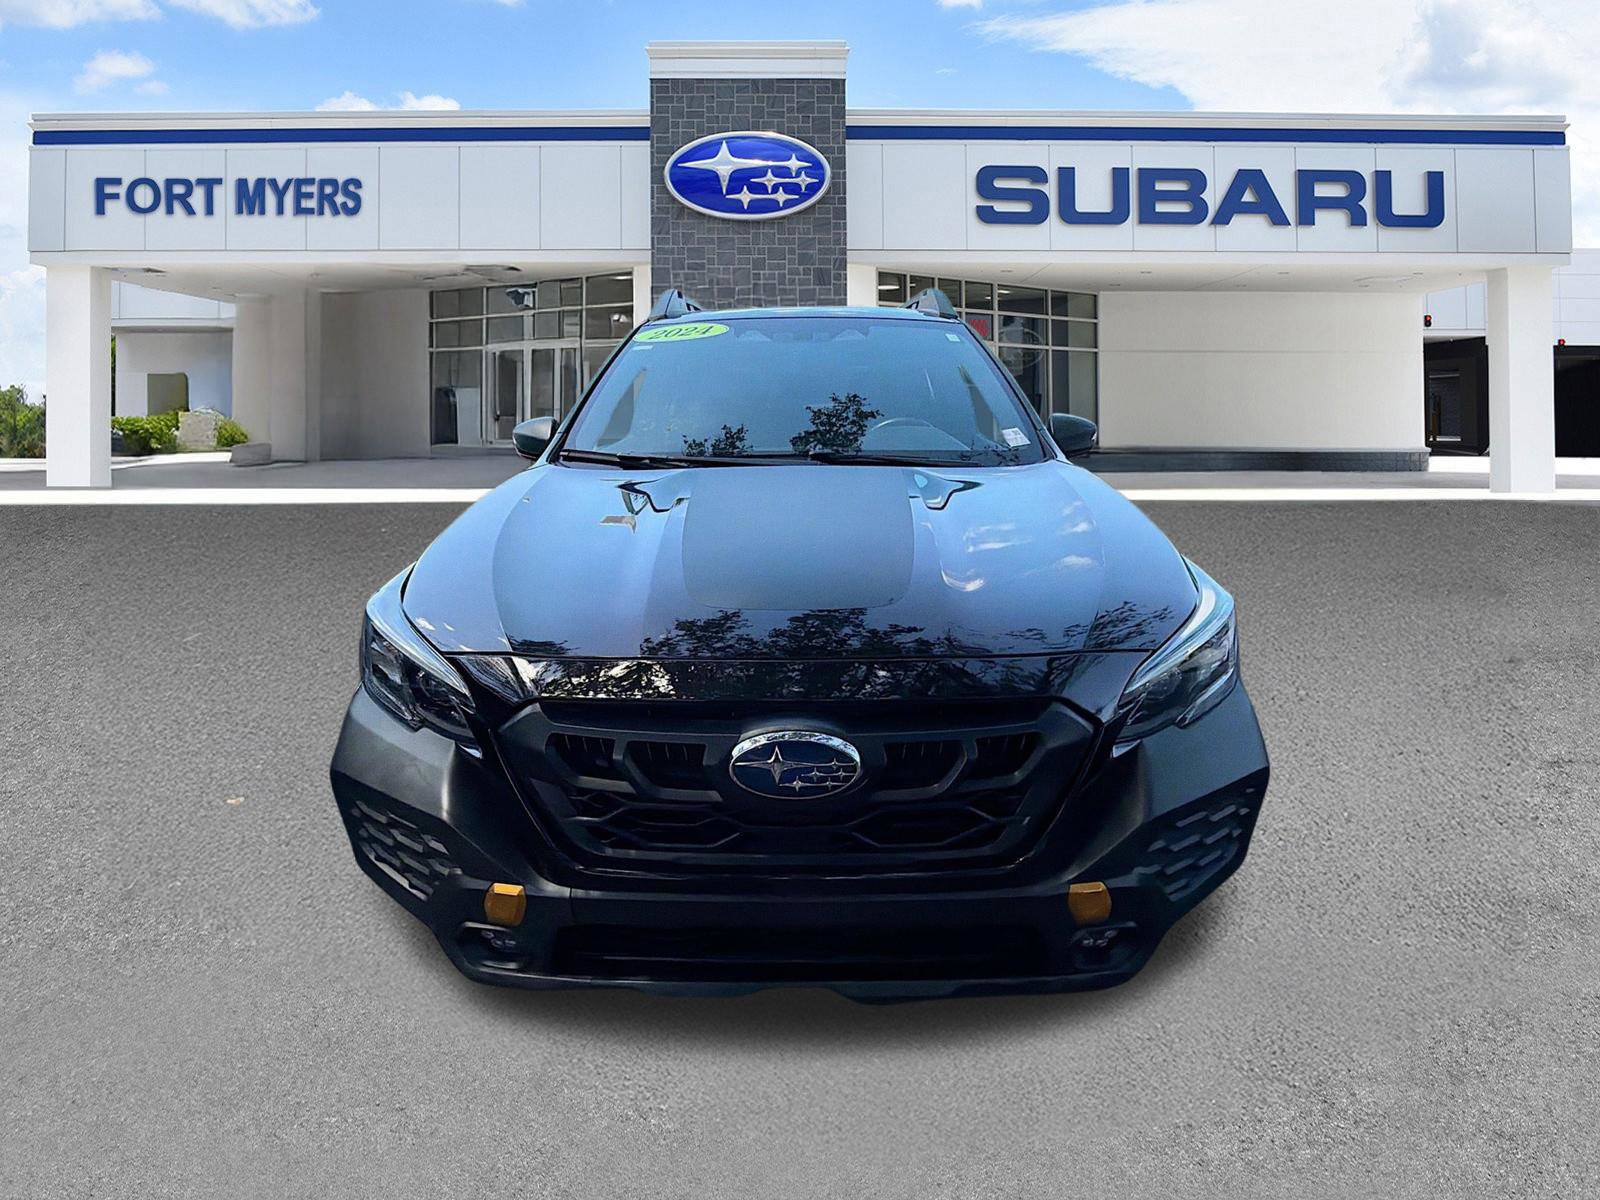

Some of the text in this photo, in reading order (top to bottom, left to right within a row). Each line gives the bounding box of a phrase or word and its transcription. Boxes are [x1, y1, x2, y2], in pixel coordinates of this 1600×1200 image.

[94, 177, 363, 217] FORT MYERS
[976, 165, 1445, 228] SUBARU
